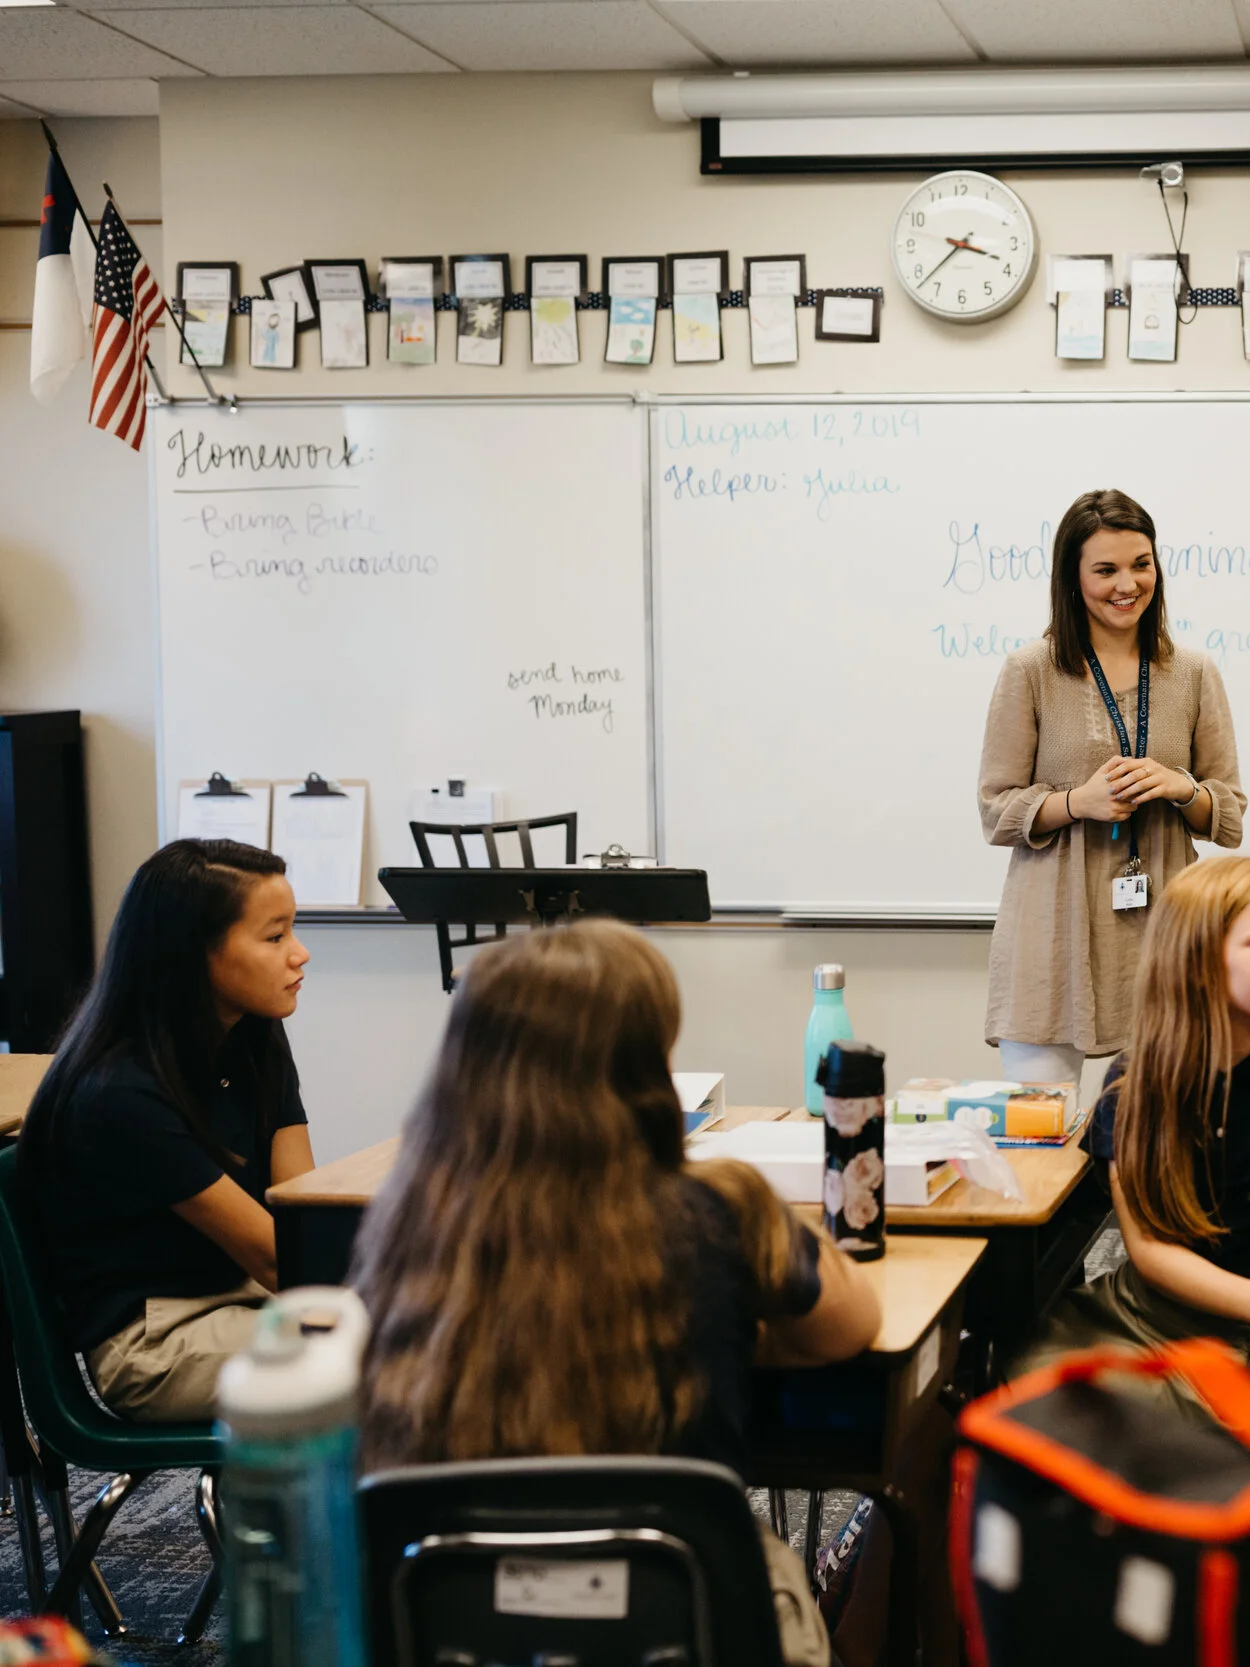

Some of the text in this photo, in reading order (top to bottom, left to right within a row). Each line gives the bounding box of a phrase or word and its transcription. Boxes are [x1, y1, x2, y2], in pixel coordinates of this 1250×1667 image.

[954, 184, 968, 196] 12
[911, 211, 925, 227] 10
[906, 238, 916, 254] 9
[1010, 236, 1018, 252] 3
[914, 264, 924, 279] 8
[1002, 263, 1012, 278] 4
[934, 281, 942, 297] 7
[957, 290, 967, 304] 6
[984, 281, 993, 296] 5
[664, 409, 797, 456] August
[168, 429, 374, 478] Homework:
[664, 465, 900, 522] Helper: Julia
[315, 551, 440, 576] recorders
[943, 520, 1052, 595] Good
[506, 662, 624, 690] send home
[1092, 666, 1113, 705] Covenant
[1109, 705, 1126, 744] Christian
[1140, 679, 1148, 718] Covenant
[528, 693, 614, 733] Monday
